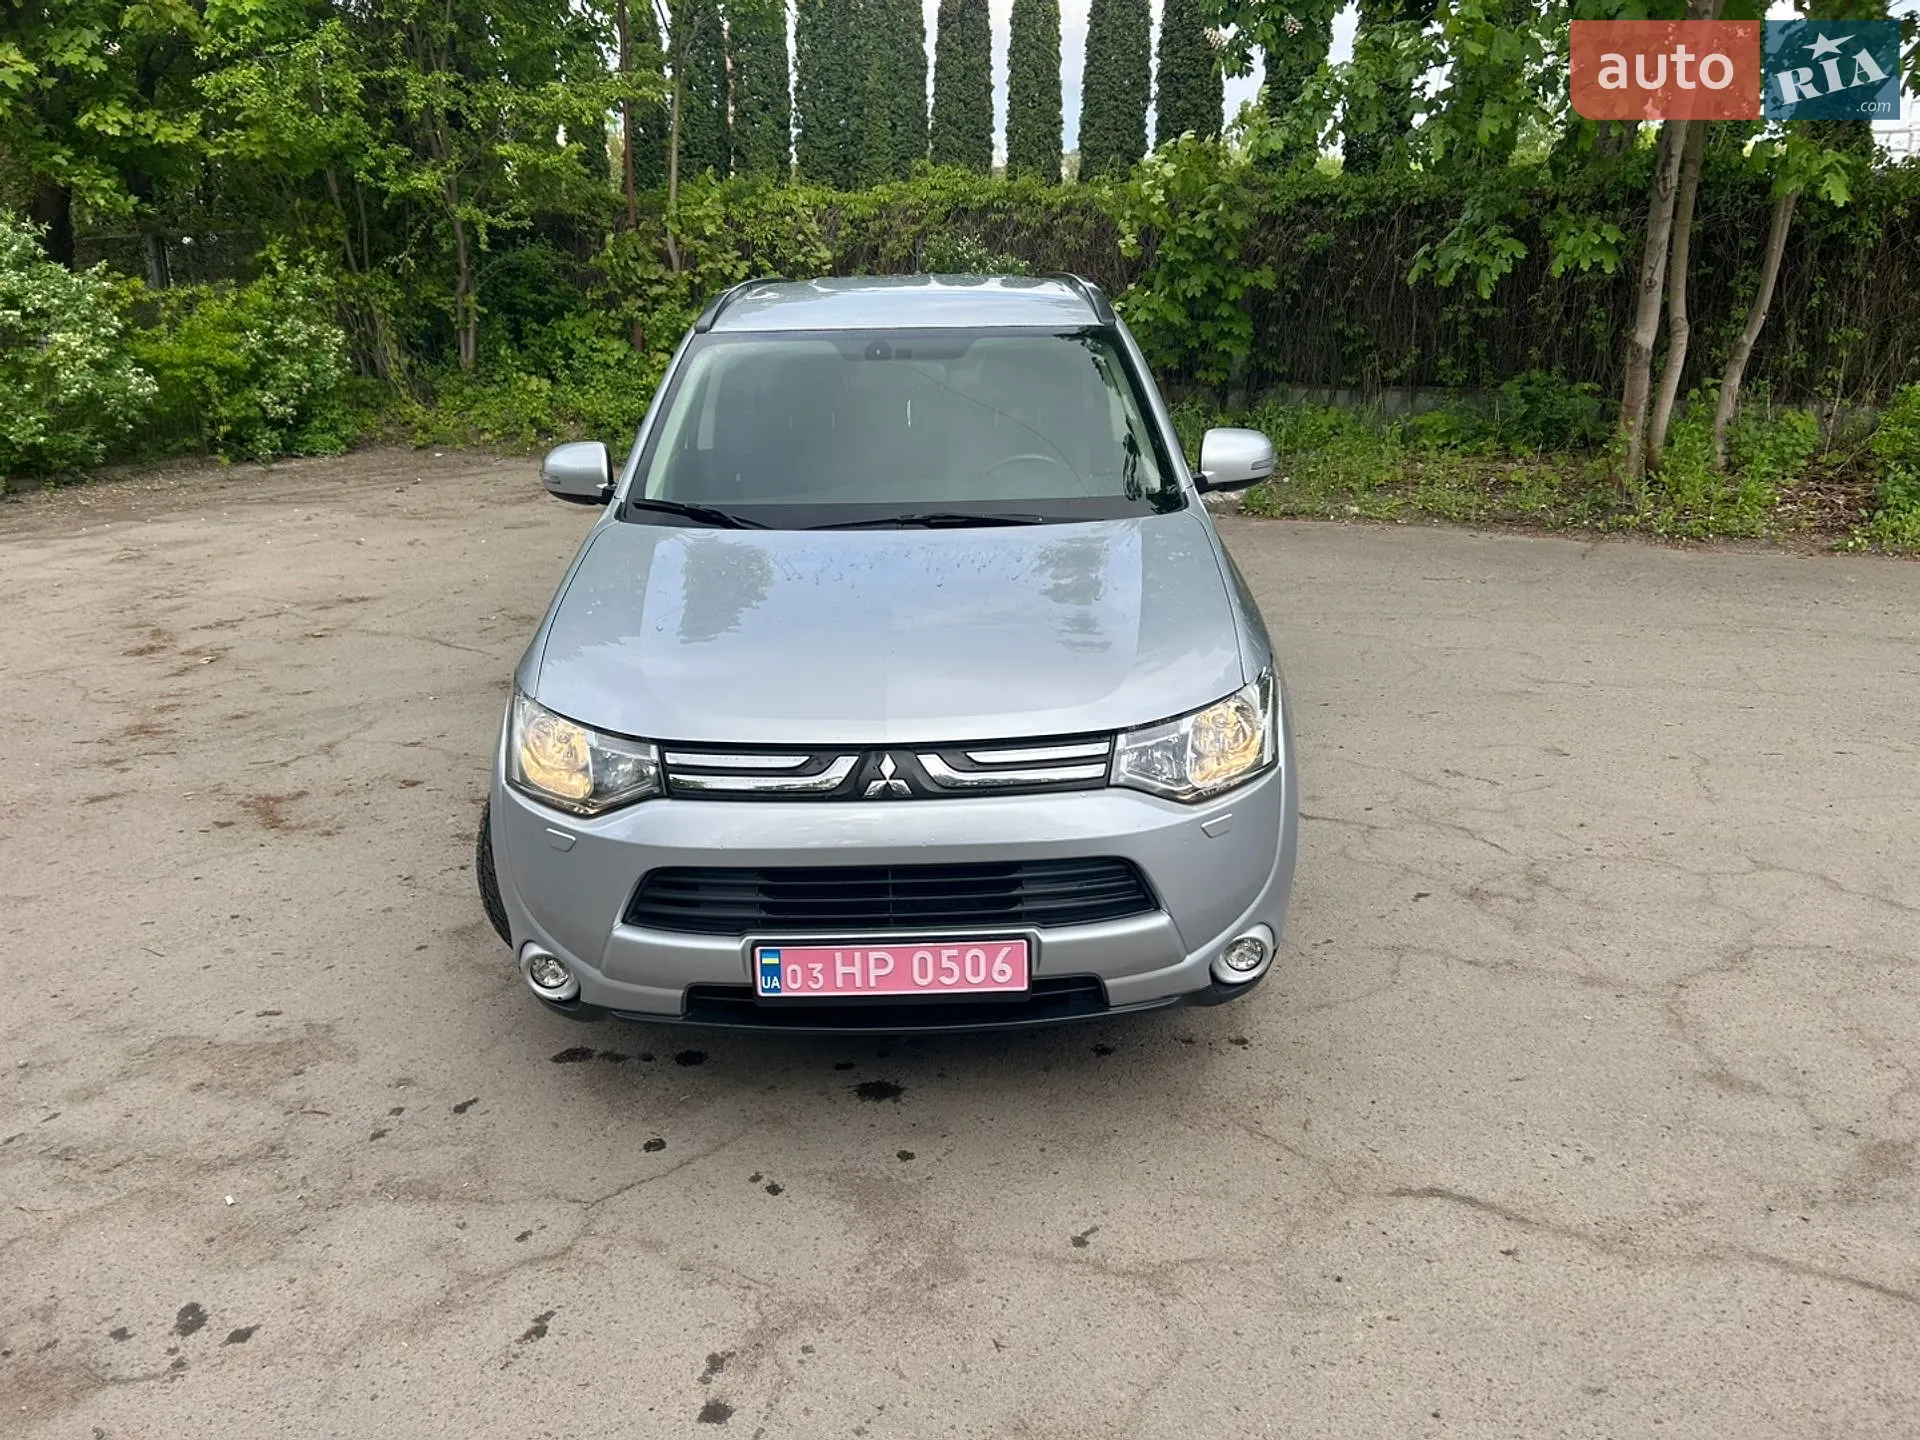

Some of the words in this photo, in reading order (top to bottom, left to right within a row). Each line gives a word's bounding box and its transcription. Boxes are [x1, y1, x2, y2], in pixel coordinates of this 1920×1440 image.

[761, 976, 781, 989] UA
[786, 963, 825, 990] 03
[834, 951, 895, 988] HP
[911, 947, 1014, 987] 0506
